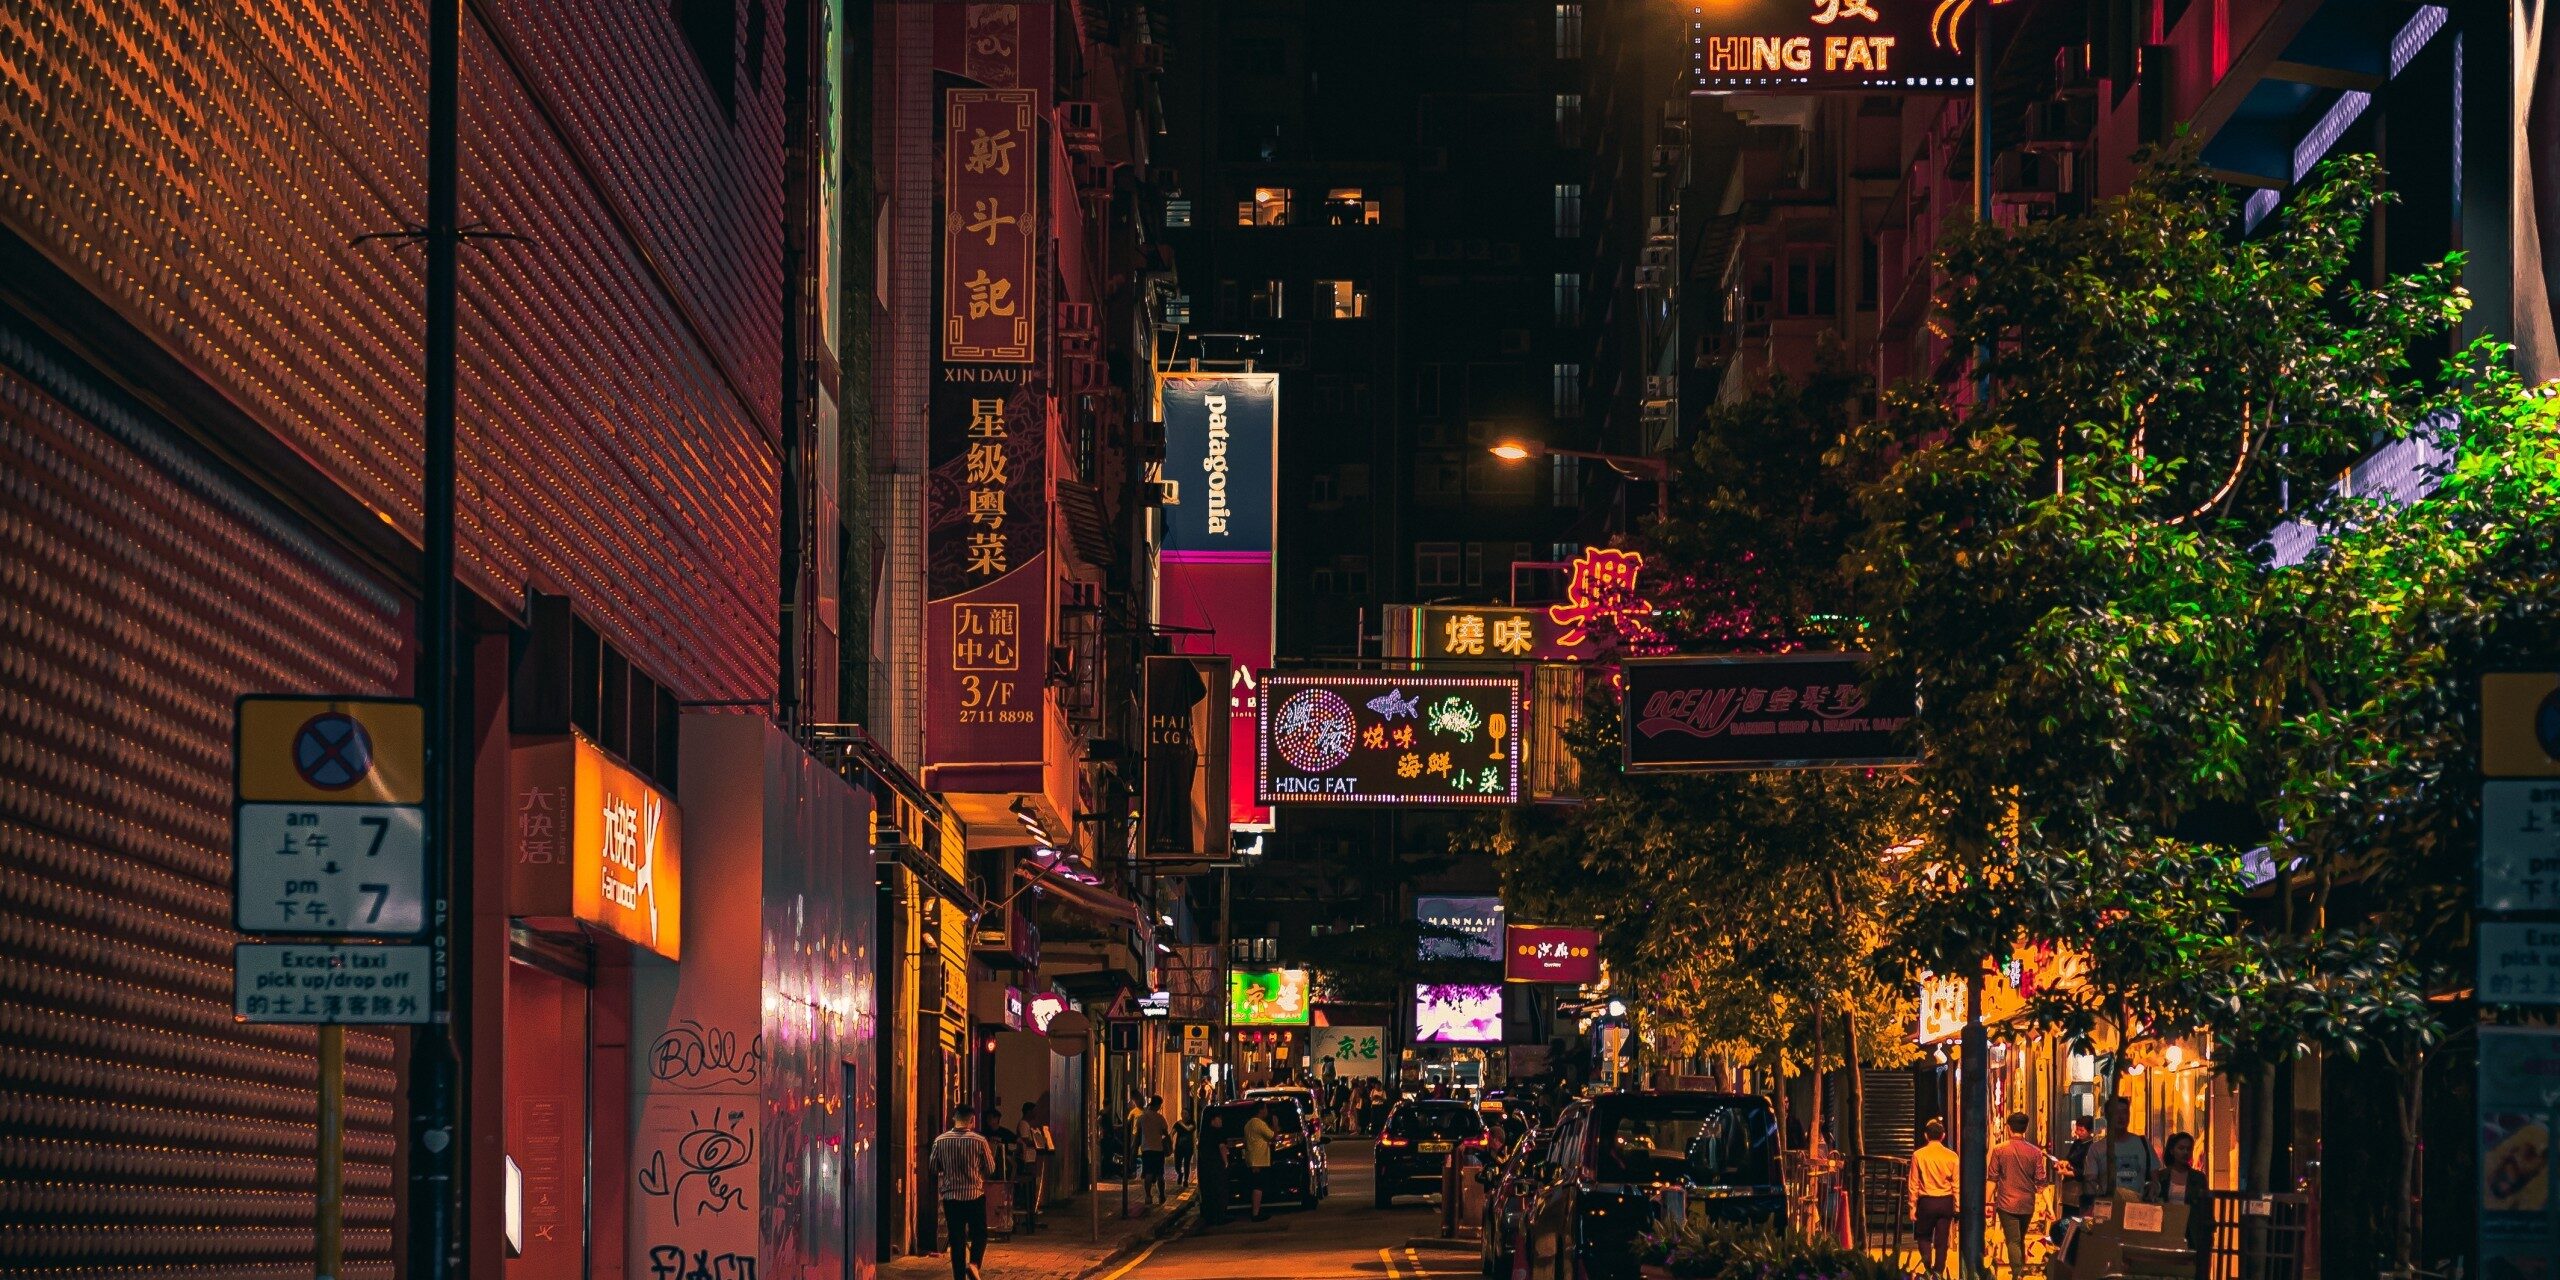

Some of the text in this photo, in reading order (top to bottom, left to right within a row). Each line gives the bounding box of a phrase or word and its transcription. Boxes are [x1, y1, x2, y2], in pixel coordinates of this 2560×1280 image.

[1709, 36, 1895, 71] HING FAT
[965, 128, 1016, 320] 新斗記
[944, 368, 976, 381] XIN
[980, 368, 1016, 381] DAU
[1203, 394, 1230, 536] patagonia
[957, 608, 1015, 636] 九龍
[1444, 614, 1533, 656] 燒味
[957, 638, 1014, 665] 中心
[960, 675, 1015, 708] 3/F
[959, 710, 1035, 723] 2711 8898
[1642, 686, 1739, 730] OCEAN
[1778, 720, 1810, 734] SHOP
[1396, 751, 1453, 779] 海鮮
[1276, 776, 1358, 794] HING FAT
[275, 833, 329, 856] 上午
[286, 812, 389, 857] am 7
[602, 792, 638, 873] 大快活
[275, 900, 329, 923] 下午
[285, 879, 390, 924] pm 7
[1428, 917, 1496, 926] HANNAH
[281, 952, 387, 970] Except taxi
[256, 972, 410, 990] pick up/drop off
[246, 995, 417, 1016] 的士上落客除外
